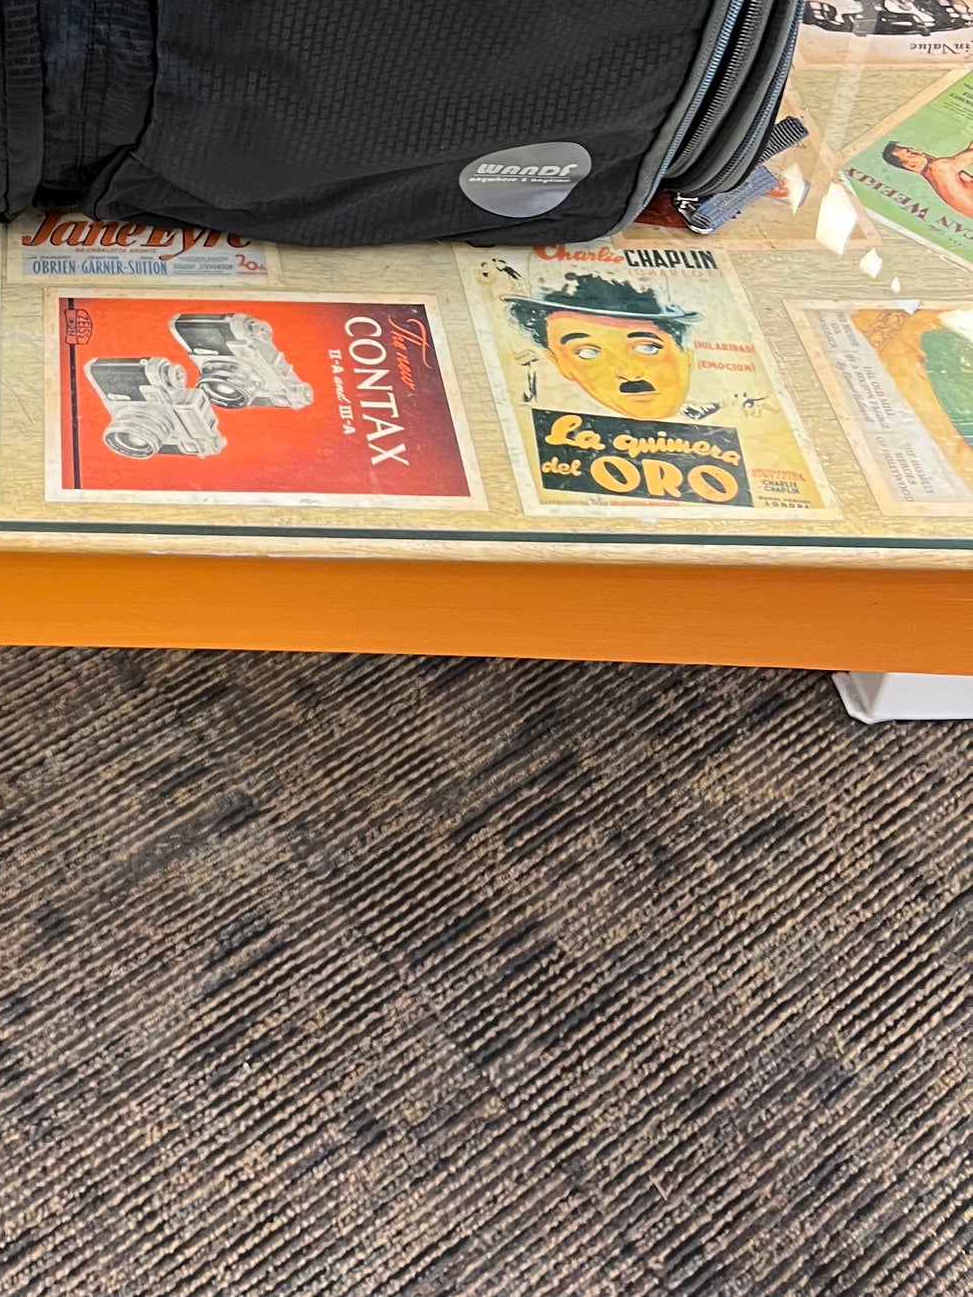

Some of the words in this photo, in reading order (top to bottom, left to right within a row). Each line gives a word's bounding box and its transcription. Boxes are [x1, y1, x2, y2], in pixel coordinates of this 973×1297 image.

[845, 166, 930, 221] WEEKLY
[21, 209, 146, 247] Jane
[81, 261, 125, 275] GARNER
[128, 261, 167, 275] SUTTON
[532, 243, 626, 264] Charlie
[624, 249, 718, 270] CHAPLIN
[344, 316, 410, 466] CONTAX
[396, 352, 416, 391] new
[544, 414, 606, 450] La
[612, 431, 741, 466] quimera
[541, 456, 582, 476] del
[589, 455, 739, 502] ORO
